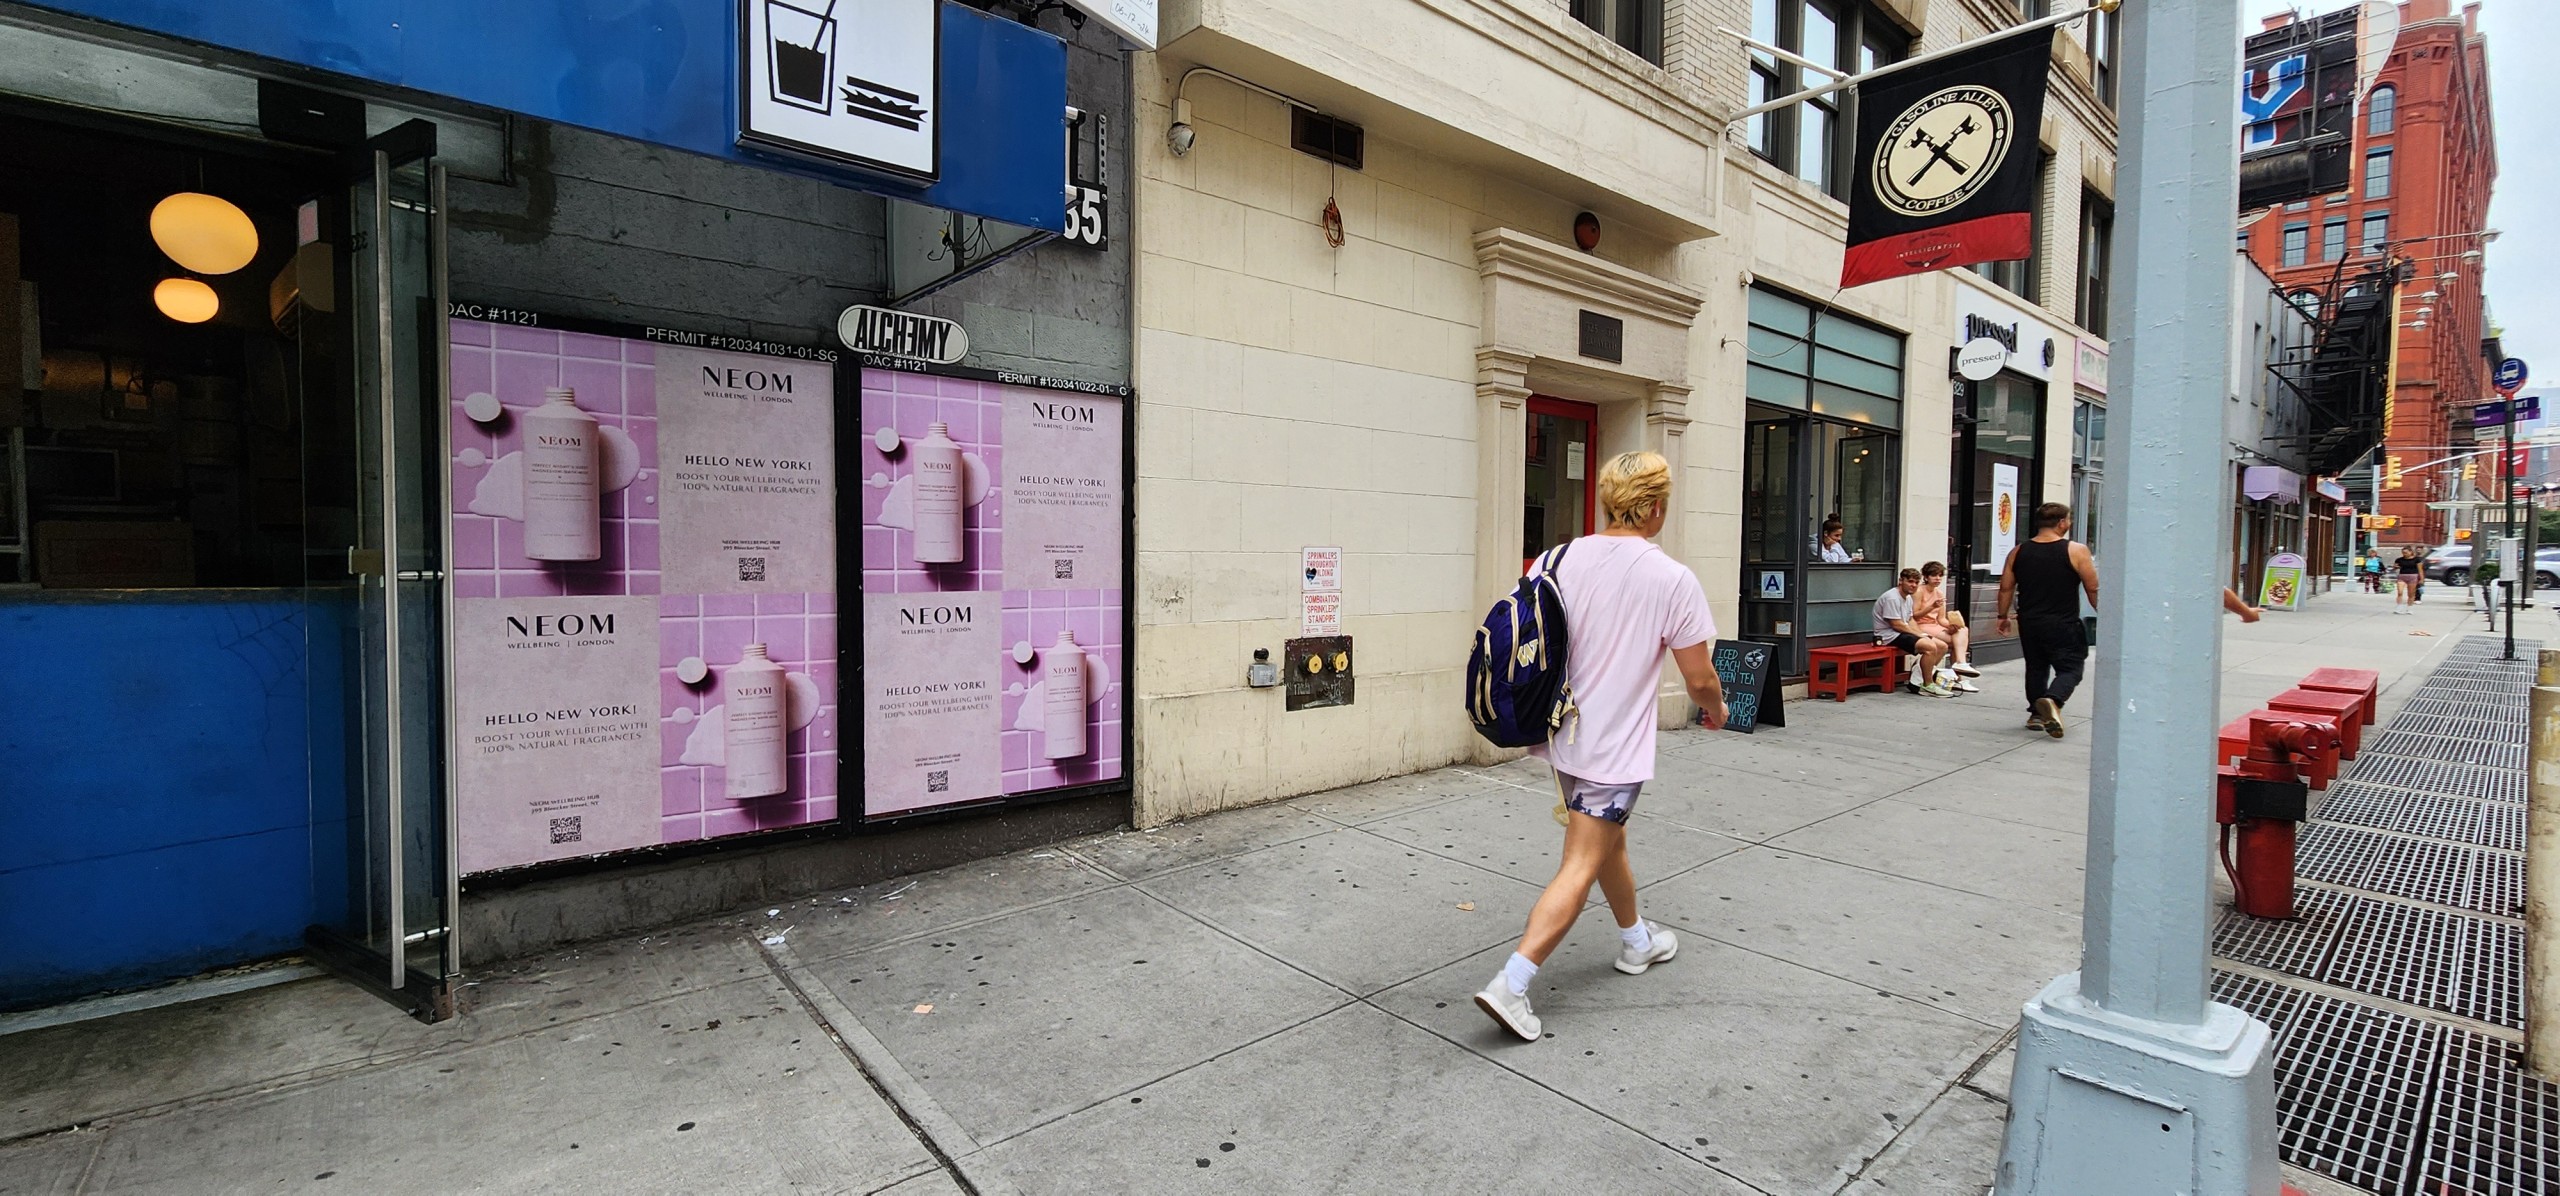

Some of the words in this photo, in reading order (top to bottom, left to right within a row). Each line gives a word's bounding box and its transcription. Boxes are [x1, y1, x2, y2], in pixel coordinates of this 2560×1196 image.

[1892, 92, 1958, 137] GASOLINE
[1958, 91, 2001, 112] ALLEY
[1905, 188, 1965, 211] COFFEE
[487, 307, 538, 325] #1121
[710, 335, 838, 362] #120341031-01-SG
[863, 354, 891, 367] OAC
[893, 358, 928, 372] #1121
[1961, 352, 2001, 367] pressed
[702, 366, 793, 394] NEOM
[997, 371, 1038, 386] PERMIT
[1954, 381, 1965, 397] 329
[703, 391, 748, 400] WELLBEING
[761, 396, 793, 404] LONDON
[1032, 402, 1094, 424] NEOM
[1033, 422, 1063, 430] WELLBEING
[538, 436, 581, 447] NEOM
[685, 455, 729, 467] HELLO
[735, 458, 766, 468] NEW
[771, 460, 811, 470] YORK!
[923, 462, 952, 471] NEOM
[676, 473, 710, 481] BOOST
[713, 474, 740, 482] YOUR
[743, 476, 794, 485] WELLBEING
[1019, 475, 1050, 484] HELLO
[1053, 477, 1075, 486] NEW
[1078, 478, 1106, 487] YORK!
[683, 483, 710, 491] 100%
[713, 484, 754, 492] NATURAL
[758, 485, 816, 494] FRAGRANCES
[1058, 491, 1094, 499] WELLBEING
[1039, 498, 1067, 506] NATURAL
[1307, 551, 1337, 560] SPRINKLERS
[1306, 560, 1338, 568] THROUGHOUT
[1765, 575, 1780, 591] A
[1305, 595, 1339, 604] COMBINATION
[900, 606, 972, 626] NEOM
[1308, 615, 1336, 624] STANDPIPE
[507, 613, 614, 638] NEOM
[507, 641, 560, 649] WELLBEING
[1517, 638, 1539, 668] W
[1718, 648, 1739, 660] ICED
[1052, 666, 1077, 675] NEOM
[1715, 659, 1741, 672] PEACH
[1717, 671, 1737, 683] REEN
[1740, 672, 1755, 686] TEA
[737, 686, 772, 696] NEOM
[886, 685, 921, 696] HELLO
[925, 683, 950, 693] NEW
[954, 680, 986, 690] YORK!
[879, 702, 906, 711] BOOST
[908, 700, 929, 708] YOUR
[931, 696, 972, 706] WELLBEING
[974, 694, 993, 702] WITH
[1736, 692, 1756, 705] ICED
[486, 712, 538, 726] HELLO
[545, 709, 582, 721] NEW
[589, 705, 637, 717] YORK!
[884, 711, 906, 719] 100%
[908, 708, 941, 717] NATURAL
[943, 703, 989, 713] FRAGRANCES
[1738, 715, 1752, 728] TEA
[475, 733, 514, 744] BOOST
[519, 730, 551, 740] YOUR
[555, 724, 616, 736] WELLBEING
[619, 722, 648, 731] WITH
[483, 744, 515, 754] 100%
[519, 739, 569, 750] NATURAL
[573, 732, 642, 746] FRAGRANCES
